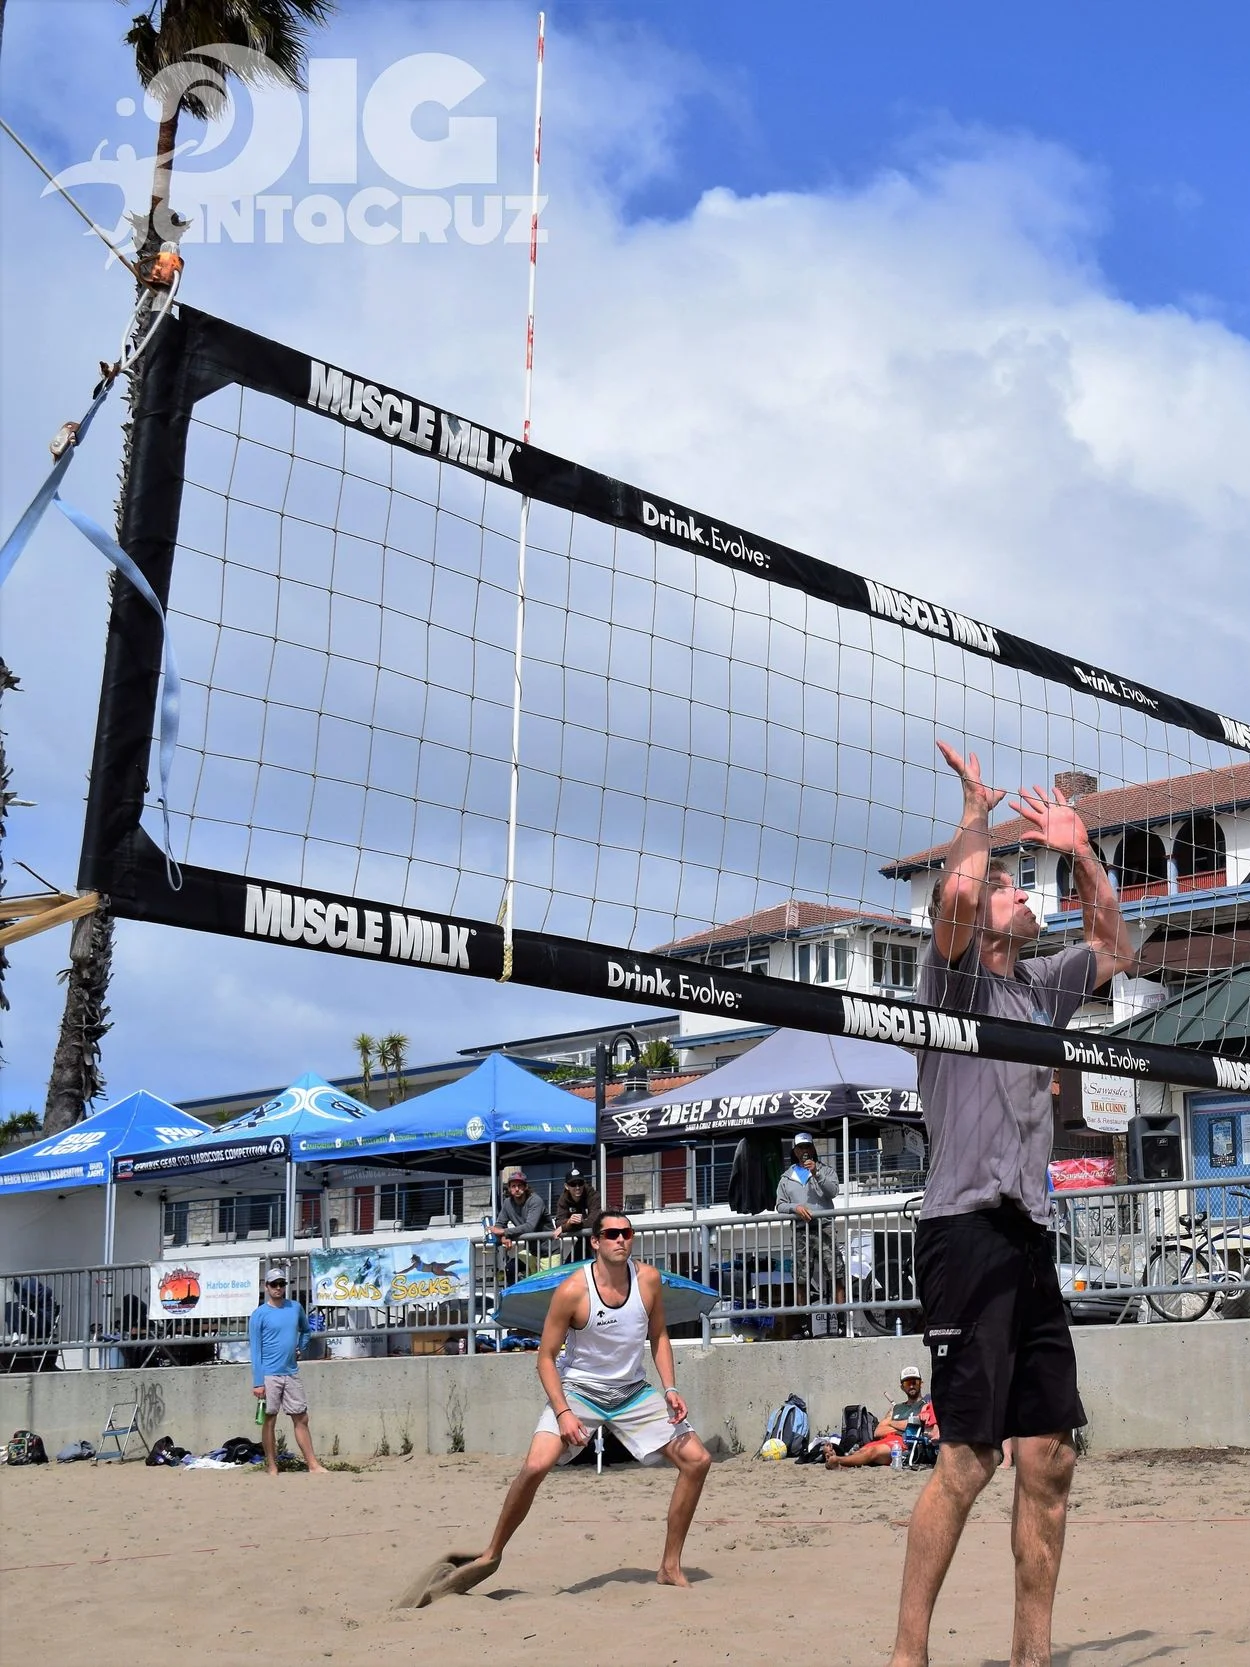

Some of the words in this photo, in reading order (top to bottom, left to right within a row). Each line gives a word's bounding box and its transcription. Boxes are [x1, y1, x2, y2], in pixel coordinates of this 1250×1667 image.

[307, 360, 436, 453] MUSCLE
[438, 411, 516, 483] MILK
[864, 578, 950, 638] MUSCLE
[948, 609, 1000, 657] MILK
[243, 883, 383, 956] MUSCLE
[388, 911, 471, 970] MILK
[842, 996, 927, 1047] MUSCLE
[928, 1012, 980, 1054] MILK
[658, 1100, 713, 1127] 2DEEP
[717, 1092, 783, 1119] SPORTS
[1091, 1101, 1105, 1111] THAI
[1105, 1103, 1127, 1113] CUISINE
[712, 1119, 727, 1129] BEACH
[57, 1131, 107, 1146] BUD
[191, 1151, 225, 1165] HARDCORE
[225, 1145, 268, 1160] COMPETITION
[206, 1281, 231, 1290] Harbor
[231, 1280, 251, 1289] Beach
[334, 1274, 382, 1301] SAND
[391, 1274, 452, 1300] SOCKS
